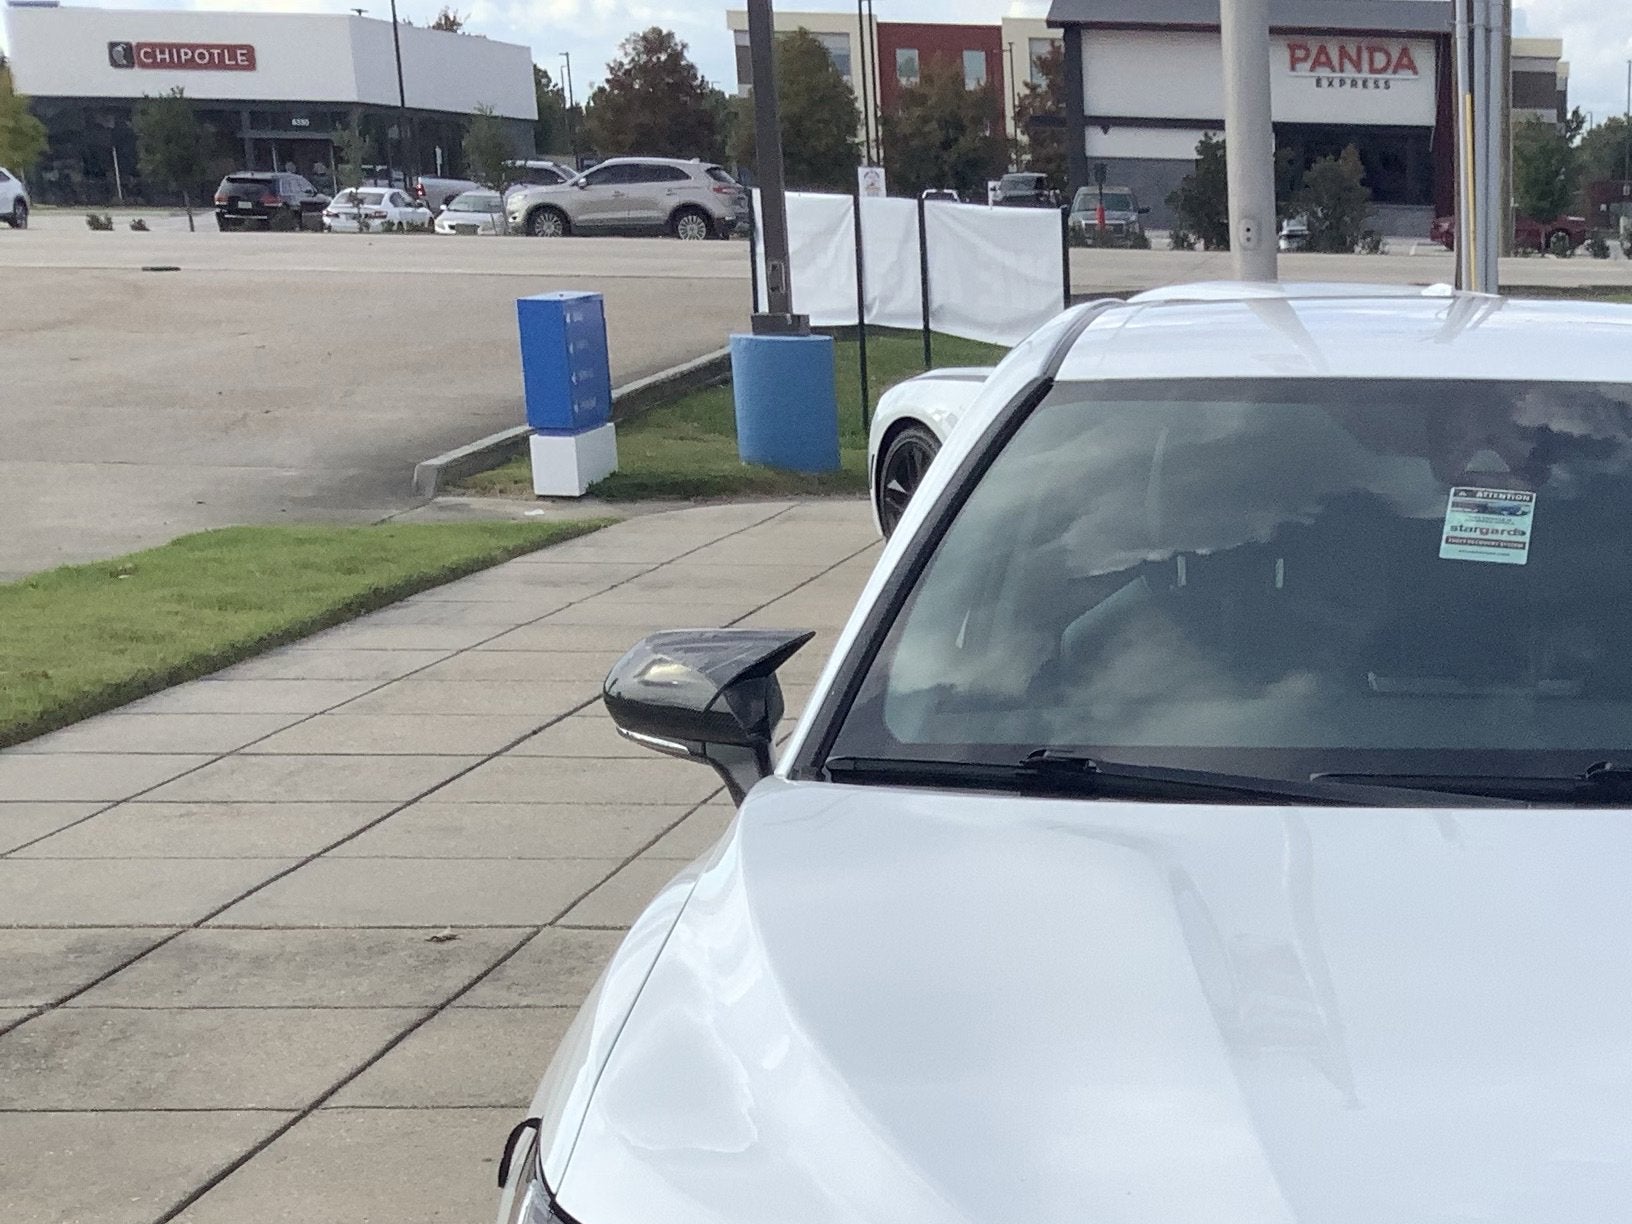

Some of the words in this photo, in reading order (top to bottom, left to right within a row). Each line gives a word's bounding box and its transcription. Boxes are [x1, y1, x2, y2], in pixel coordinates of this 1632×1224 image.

[139, 47, 249, 65] CHIPOTLE
[1287, 42, 1419, 75] PANDA
[1315, 76, 1391, 90] EXPRESS
[1475, 490, 1531, 501] ATTENTION
